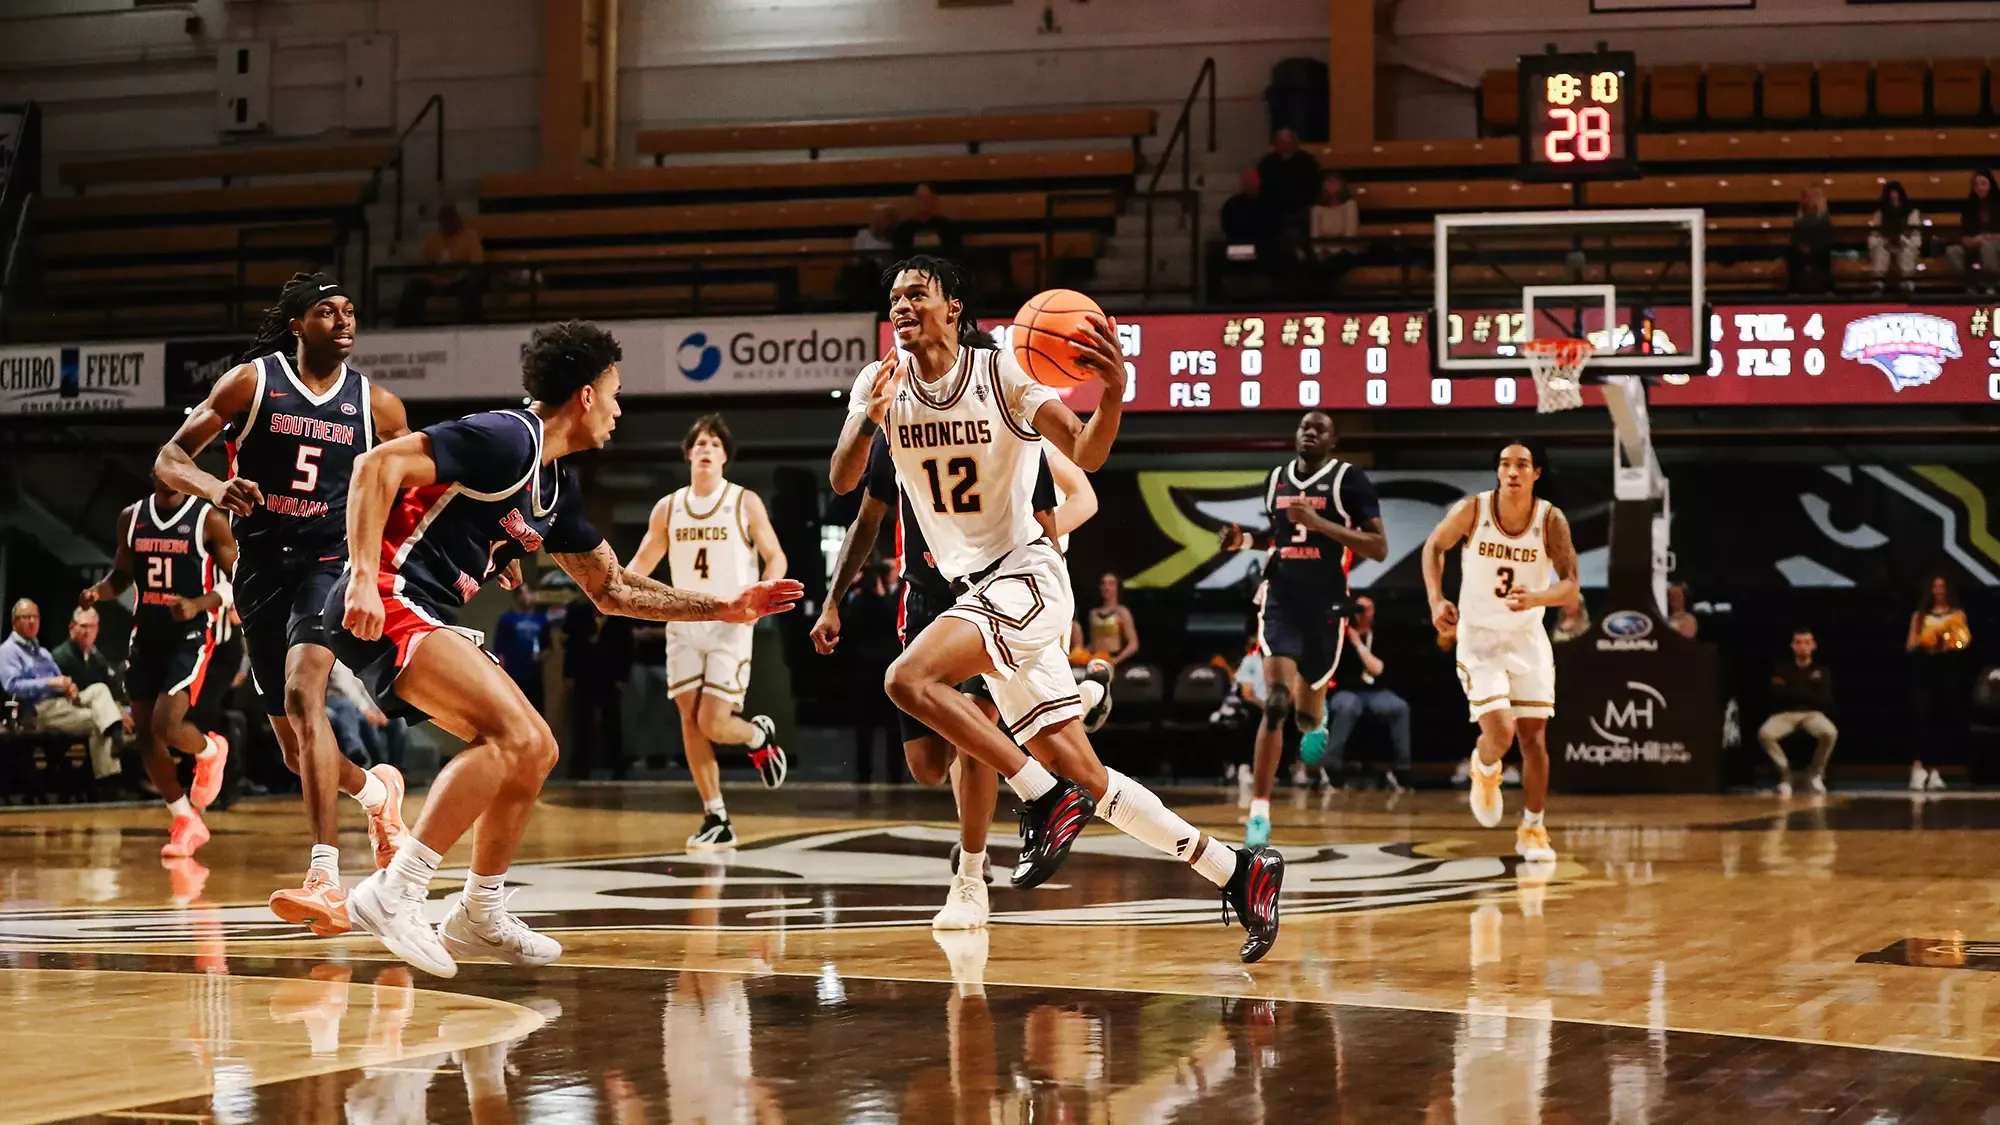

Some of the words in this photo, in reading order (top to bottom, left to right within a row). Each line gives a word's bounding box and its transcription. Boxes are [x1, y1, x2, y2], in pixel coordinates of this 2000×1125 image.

[1547, 71, 1618, 105] 18:10
[1545, 106, 1611, 163] 28
[1224, 317, 1265, 349] #2
[1281, 316, 1326, 347] #3
[1341, 315, 1391, 345] #4
[1473, 313, 1526, 343] #12
[1803, 313, 1825, 341] 4
[729, 328, 866, 366] Gordon
[1170, 350, 1217, 376] PTS
[1241, 349, 1263, 376] 0
[1301, 348, 1321, 375] 0
[1366, 347, 1387, 374] 0
[1737, 348, 1791, 377] FLS
[1803, 348, 1826, 376] 0
[0, 355, 55, 391] CHIRO
[86, 352, 145, 387] FFECT
[1170, 381, 1212, 408] FLS
[1240, 380, 1261, 408] 0
[1299, 380, 1320, 407] 0
[1366, 378, 1387, 406] 0
[1431, 378, 1452, 405] 0
[1495, 377, 1517, 405] 0
[270, 413, 354, 446] SOUTHERN
[898, 419, 992, 449] BRONCOS
[291, 443, 323, 492] 5
[921, 455, 982, 515] 12
[267, 494, 329, 518] INDIANA
[135, 538, 189, 555] SOUTHERN
[675, 526, 728, 542] BRONCOS
[693, 547, 710, 580] 4
[1478, 541, 1539, 563] BRONCOS
[147, 556, 173, 589] 21
[1494, 565, 1515, 599] 3
